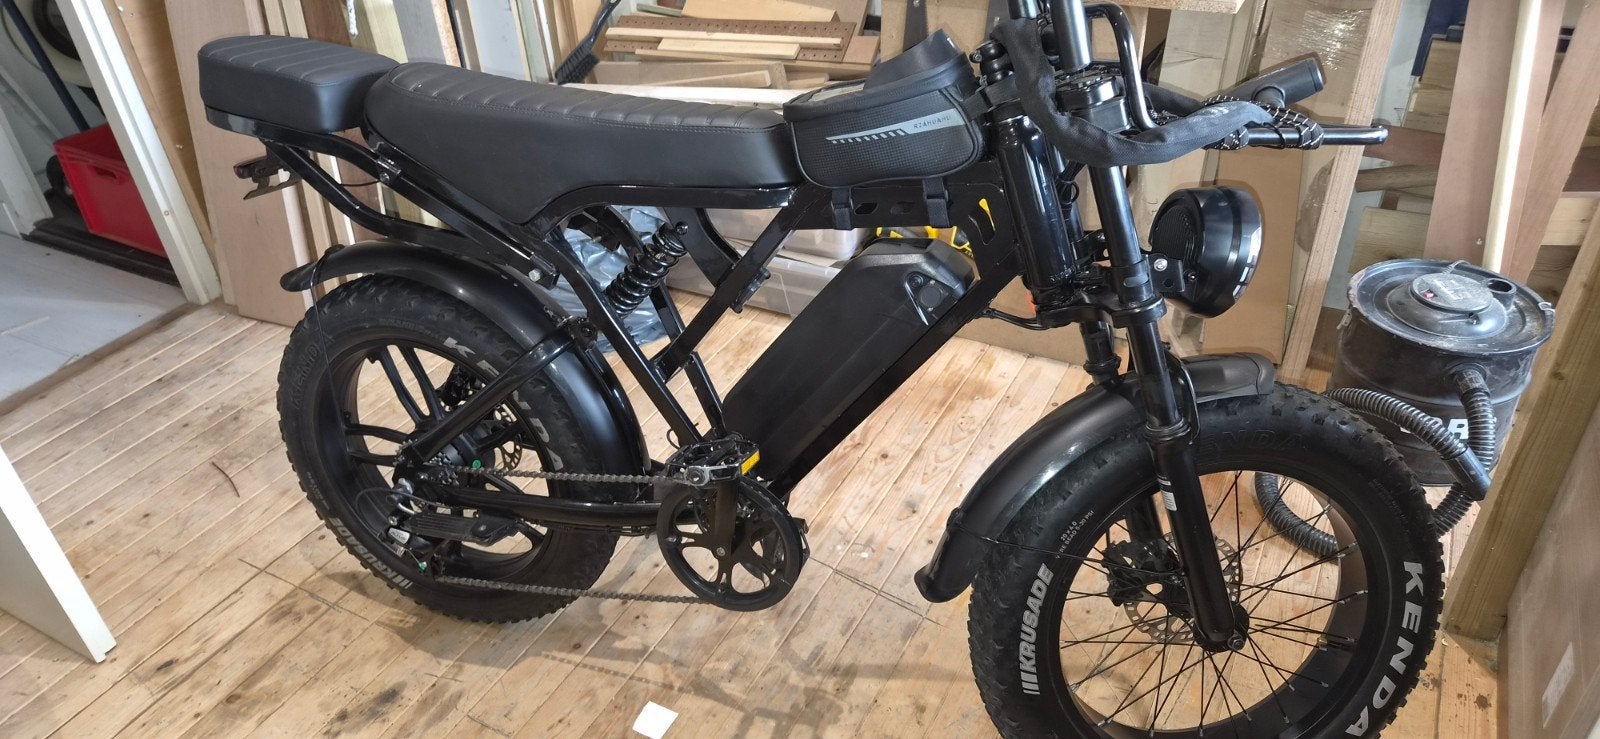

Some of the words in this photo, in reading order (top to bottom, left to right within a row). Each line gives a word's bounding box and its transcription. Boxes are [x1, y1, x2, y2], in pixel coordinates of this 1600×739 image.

[1055, 545, 1067, 559] WRE
[1084, 510, 1095, 519] PSI
[1061, 533, 1068, 541] 20
[1019, 563, 1054, 673] KRUSADE
[1345, 561, 1424, 737] KENDA
